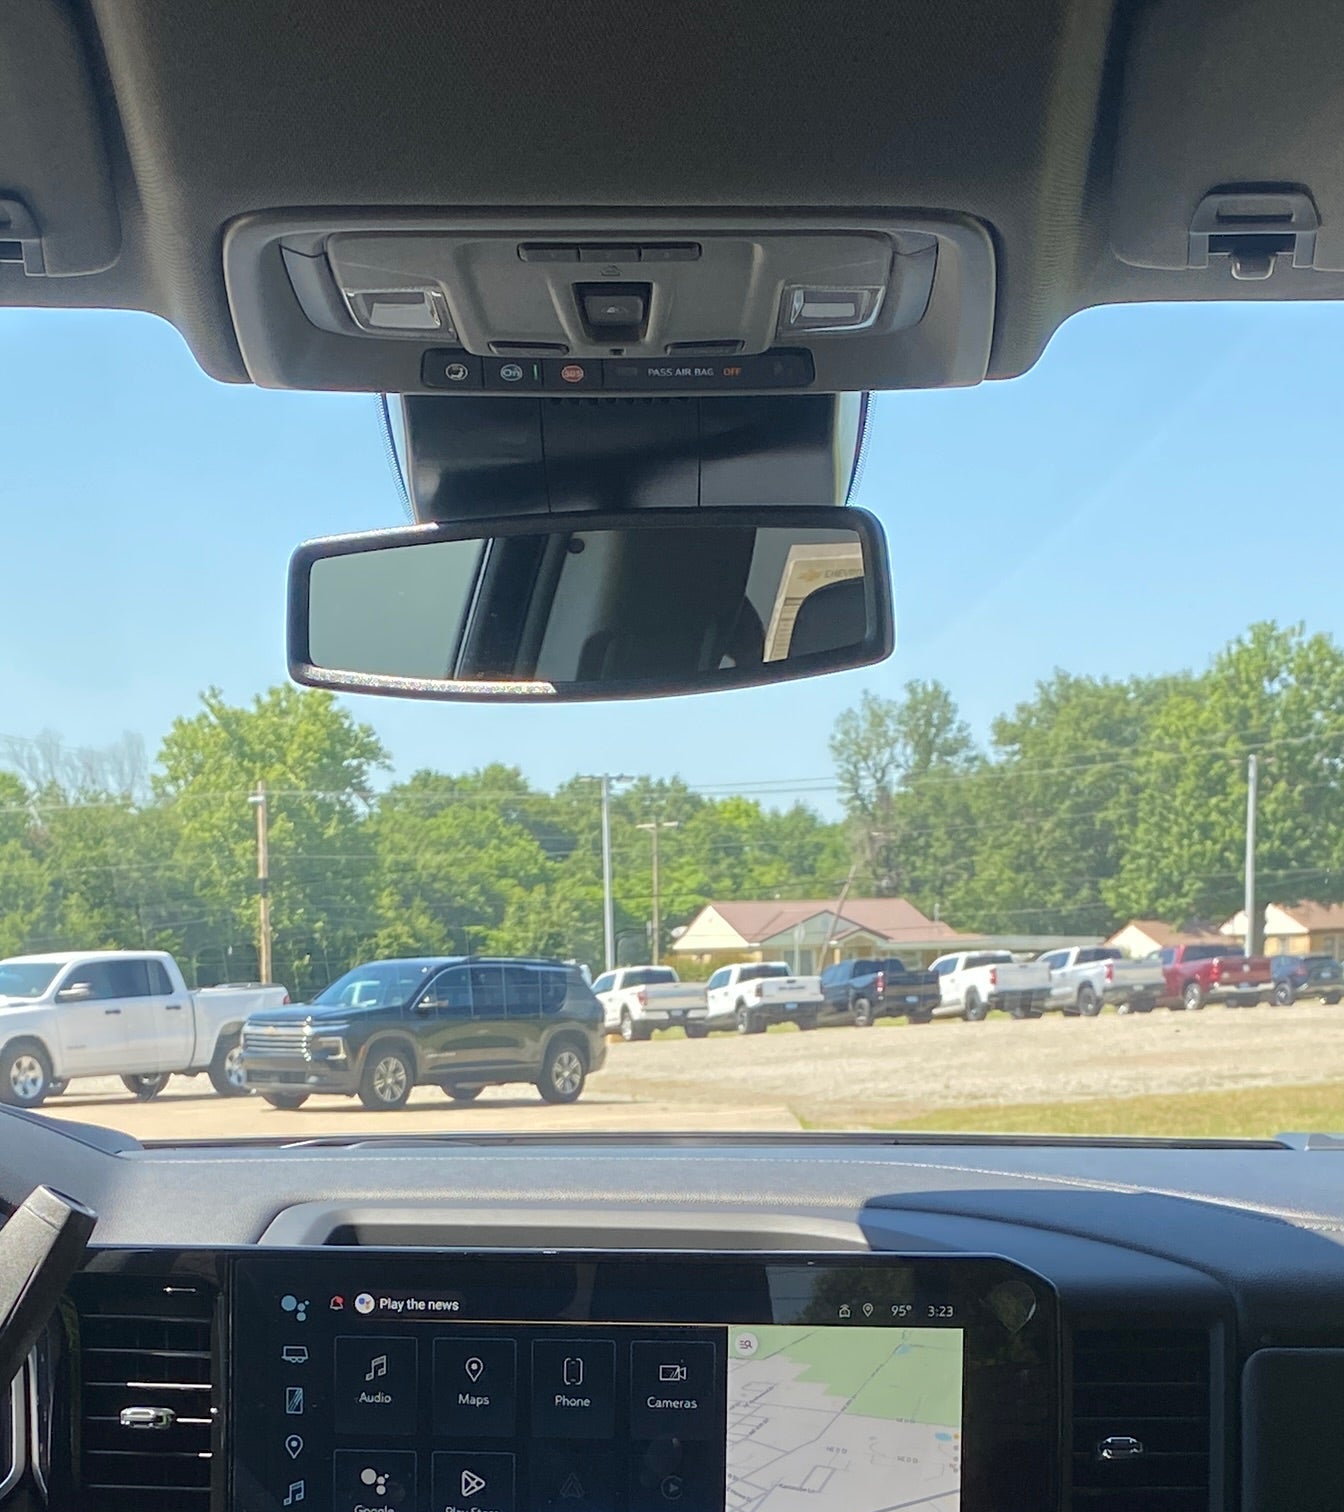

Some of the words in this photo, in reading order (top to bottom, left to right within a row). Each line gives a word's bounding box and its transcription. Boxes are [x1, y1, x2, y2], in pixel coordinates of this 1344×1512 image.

[564, 369, 580, 378] SOS
[647, 368, 673, 377] PASS
[675, 368, 691, 377] AIR
[694, 368, 714, 376] BAG
[723, 367, 742, 376] OFF
[379, 1298, 403, 1313] Play
[406, 1298, 425, 1311] the
[428, 1301, 459, 1311] news
[927, 1305, 954, 1317] 3:23
[358, 1391, 392, 1403] Audio
[458, 1393, 490, 1407] Maps
[555, 1395, 591, 1408] Phone
[647, 1396, 698, 1410] Cameras
